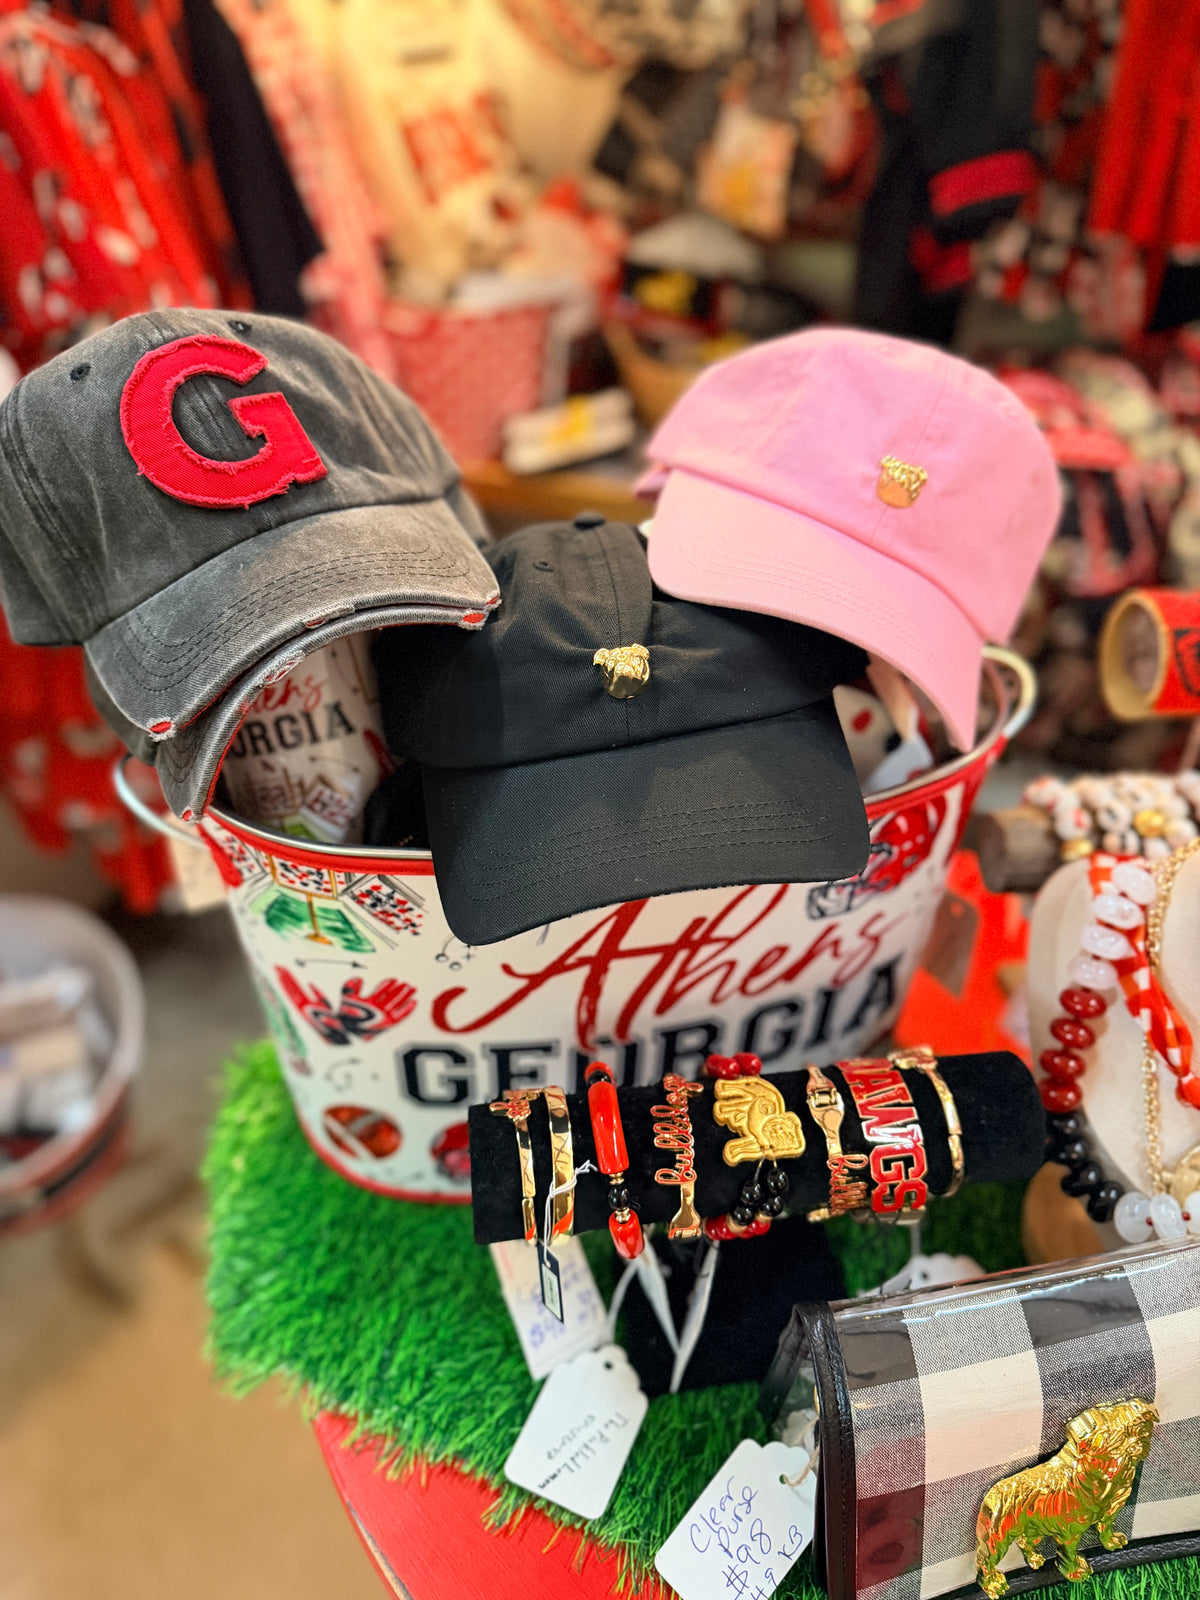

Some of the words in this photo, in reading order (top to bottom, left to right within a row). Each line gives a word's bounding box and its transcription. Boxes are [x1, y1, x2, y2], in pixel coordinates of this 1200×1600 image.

[120, 334, 327, 508] G
[834, 1058, 928, 1213] DAWGS
[690, 1475, 735, 1553] Clear
[718, 1485, 759, 1559] Purse
